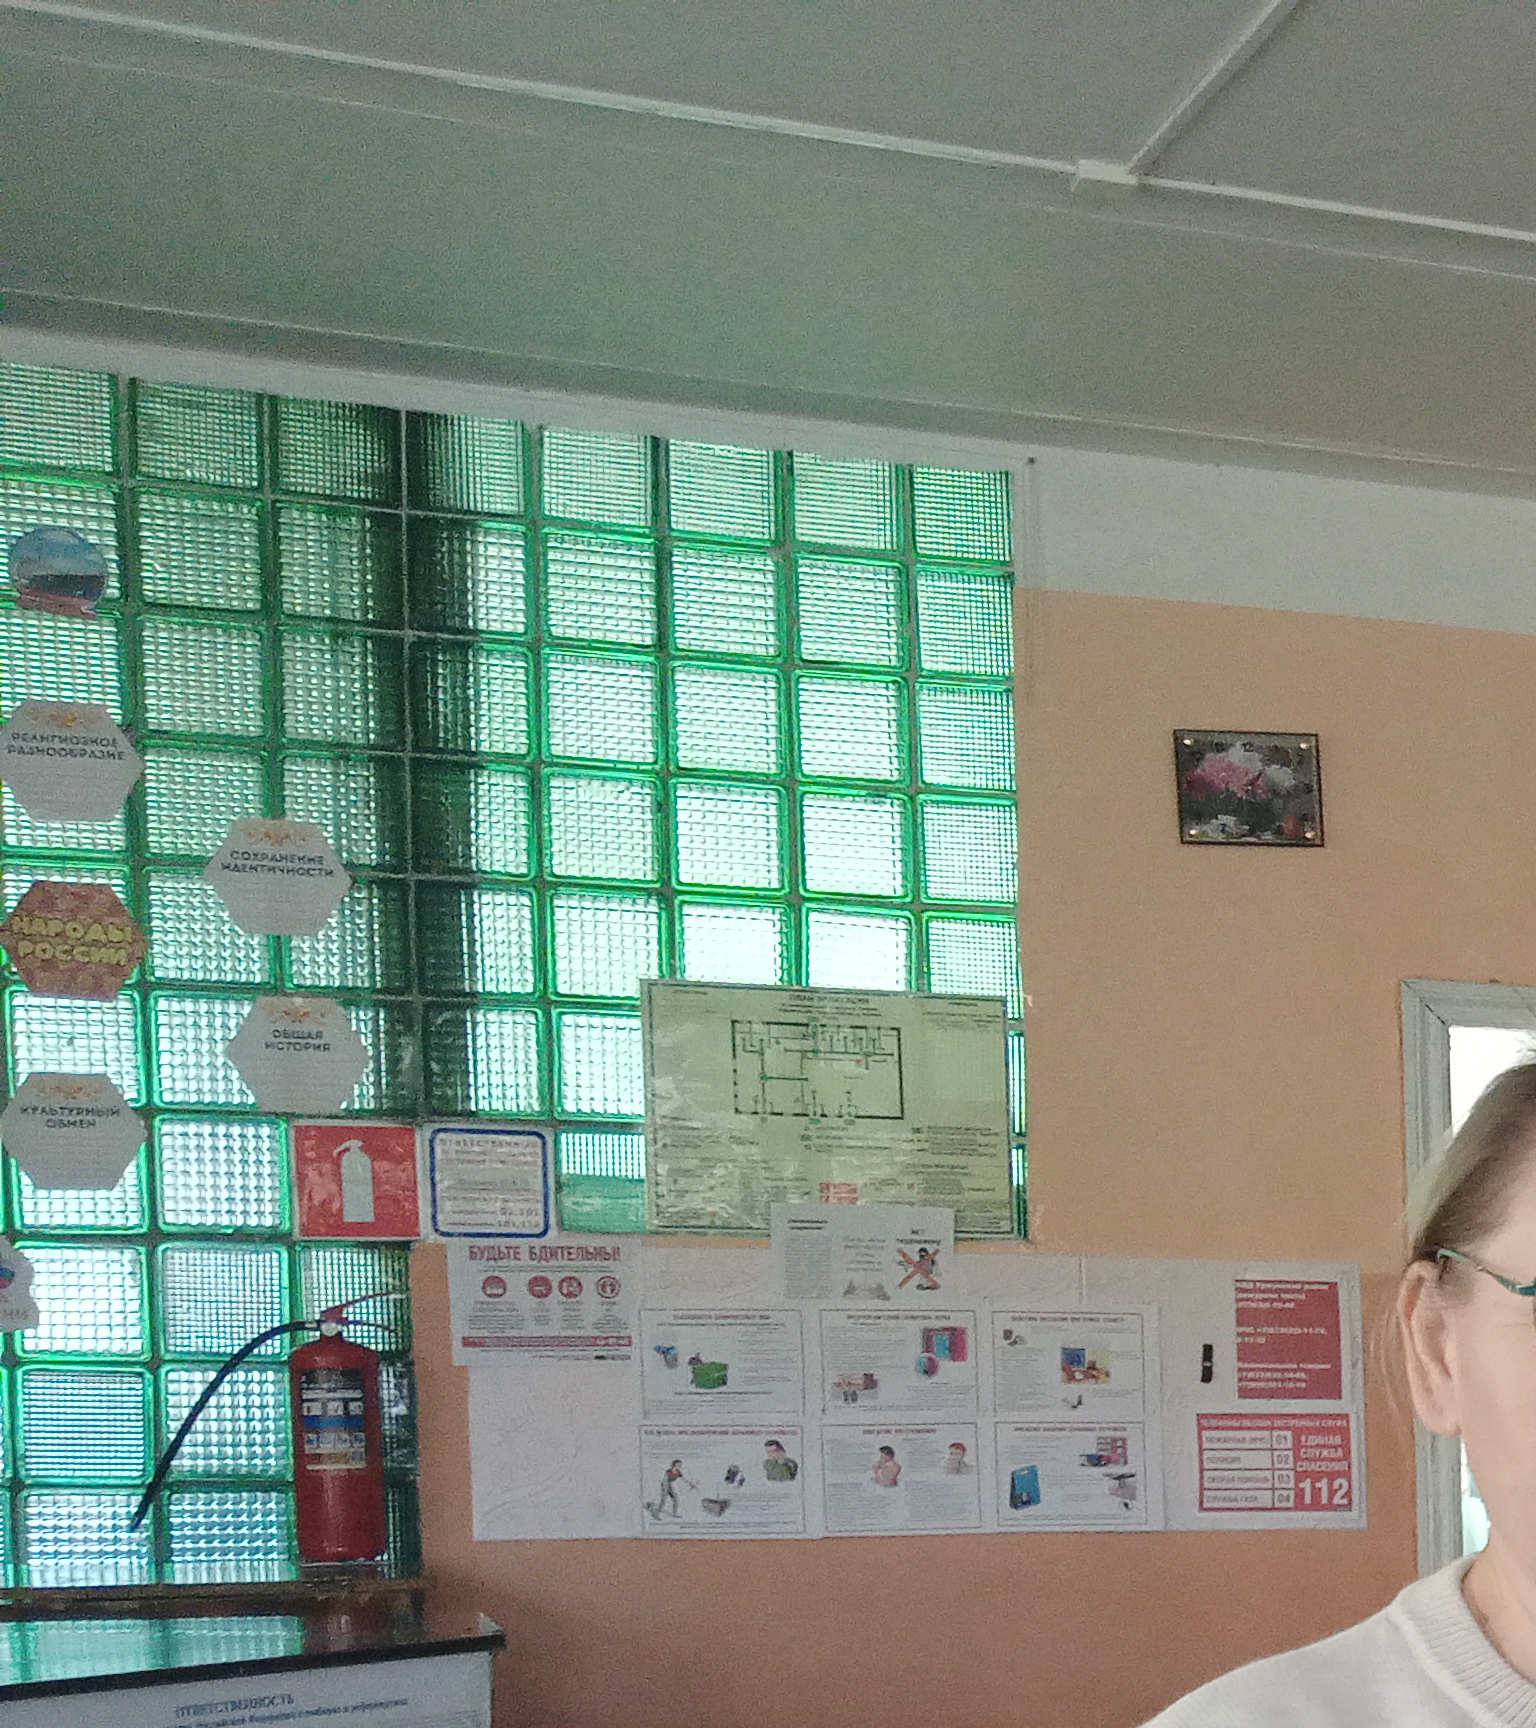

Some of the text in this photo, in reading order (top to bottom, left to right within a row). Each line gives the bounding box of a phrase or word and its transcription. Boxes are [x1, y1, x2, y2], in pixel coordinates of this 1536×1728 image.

[18, 940, 130, 966] РОССИИ
[272, 1028, 324, 1040] ОБЩАЯ
[264, 1040, 332, 1053] ИСТОРИЯ
[45, 1118, 98, 1129] ОБМЕН
[468, 1245, 521, 1262] БУДЬТЕ
[1275, 1433, 1289, 1446] 01
[1275, 1453, 1291, 1466] 02
[1298, 1476, 1350, 1506] 112
